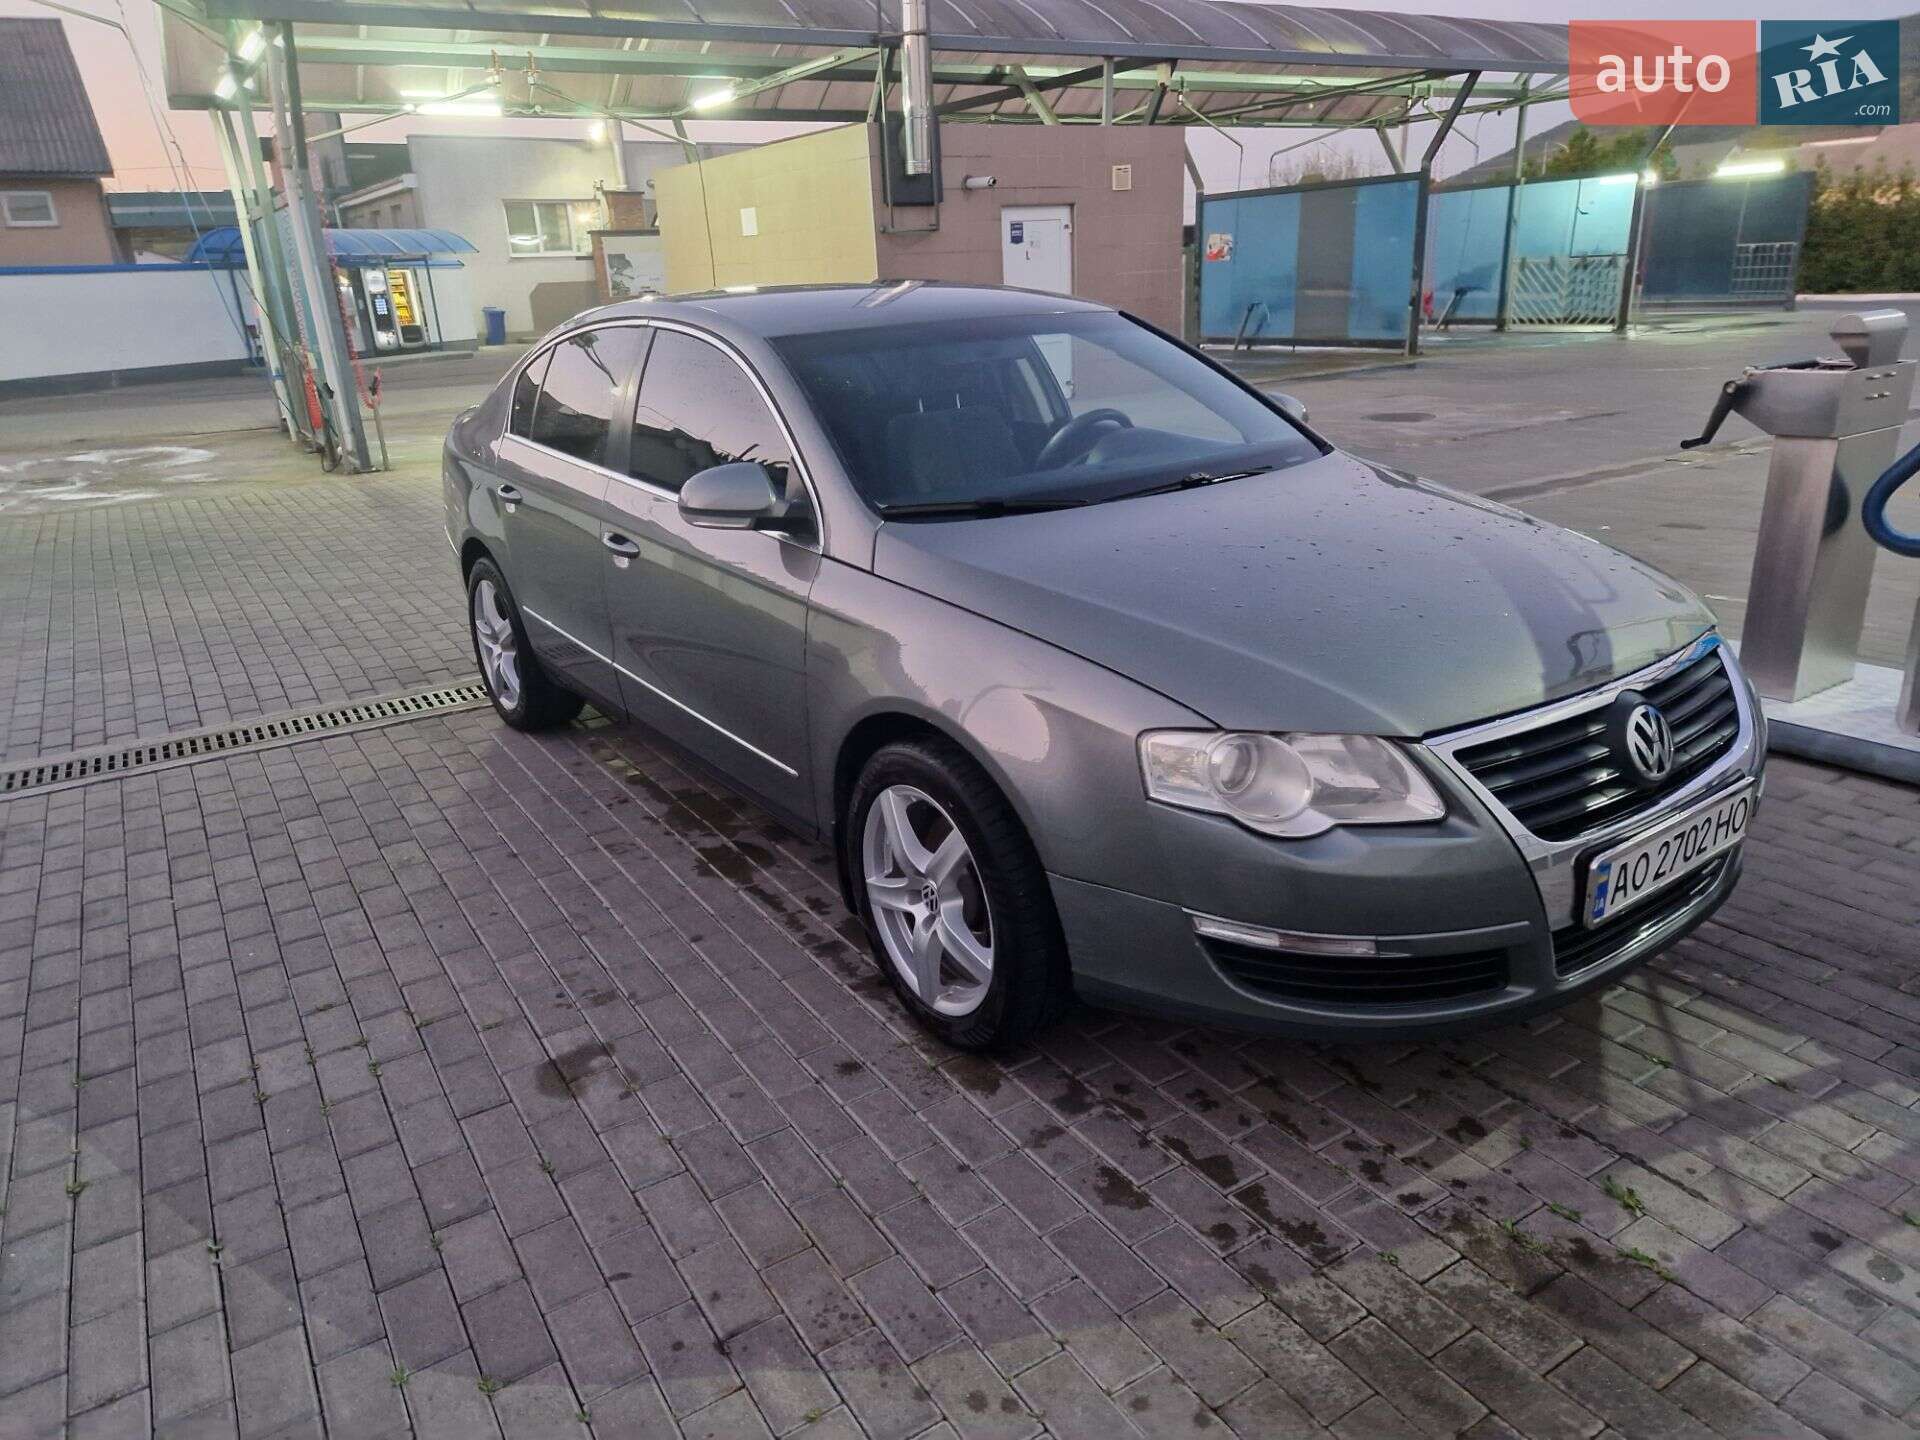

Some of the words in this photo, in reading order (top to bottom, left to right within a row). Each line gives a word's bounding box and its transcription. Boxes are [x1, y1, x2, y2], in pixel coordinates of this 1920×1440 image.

[1611, 852, 1650, 905] AO
[1653, 817, 1712, 882] 2702
[1713, 797, 1748, 846] HO
